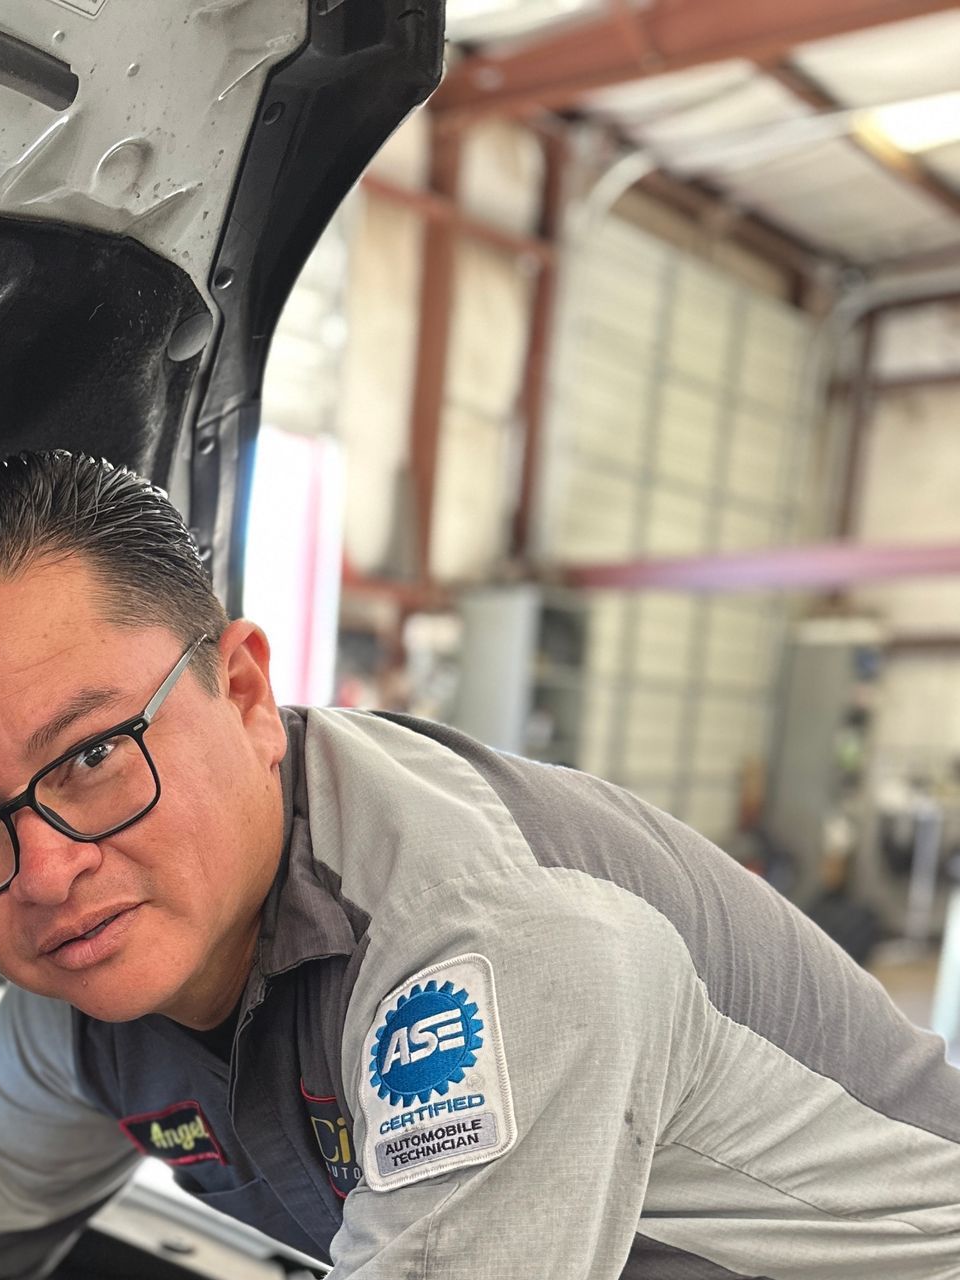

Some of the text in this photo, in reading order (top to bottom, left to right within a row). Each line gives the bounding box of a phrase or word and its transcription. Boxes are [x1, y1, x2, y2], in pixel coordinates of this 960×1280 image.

[382, 1008, 465, 1076] ASE
[151, 1115, 210, 1150] Angel
[380, 1093, 485, 1135] CERTIFIED
[385, 1119, 482, 1156] AUTOMOBILE
[392, 1133, 479, 1167] TECHNICIAN
